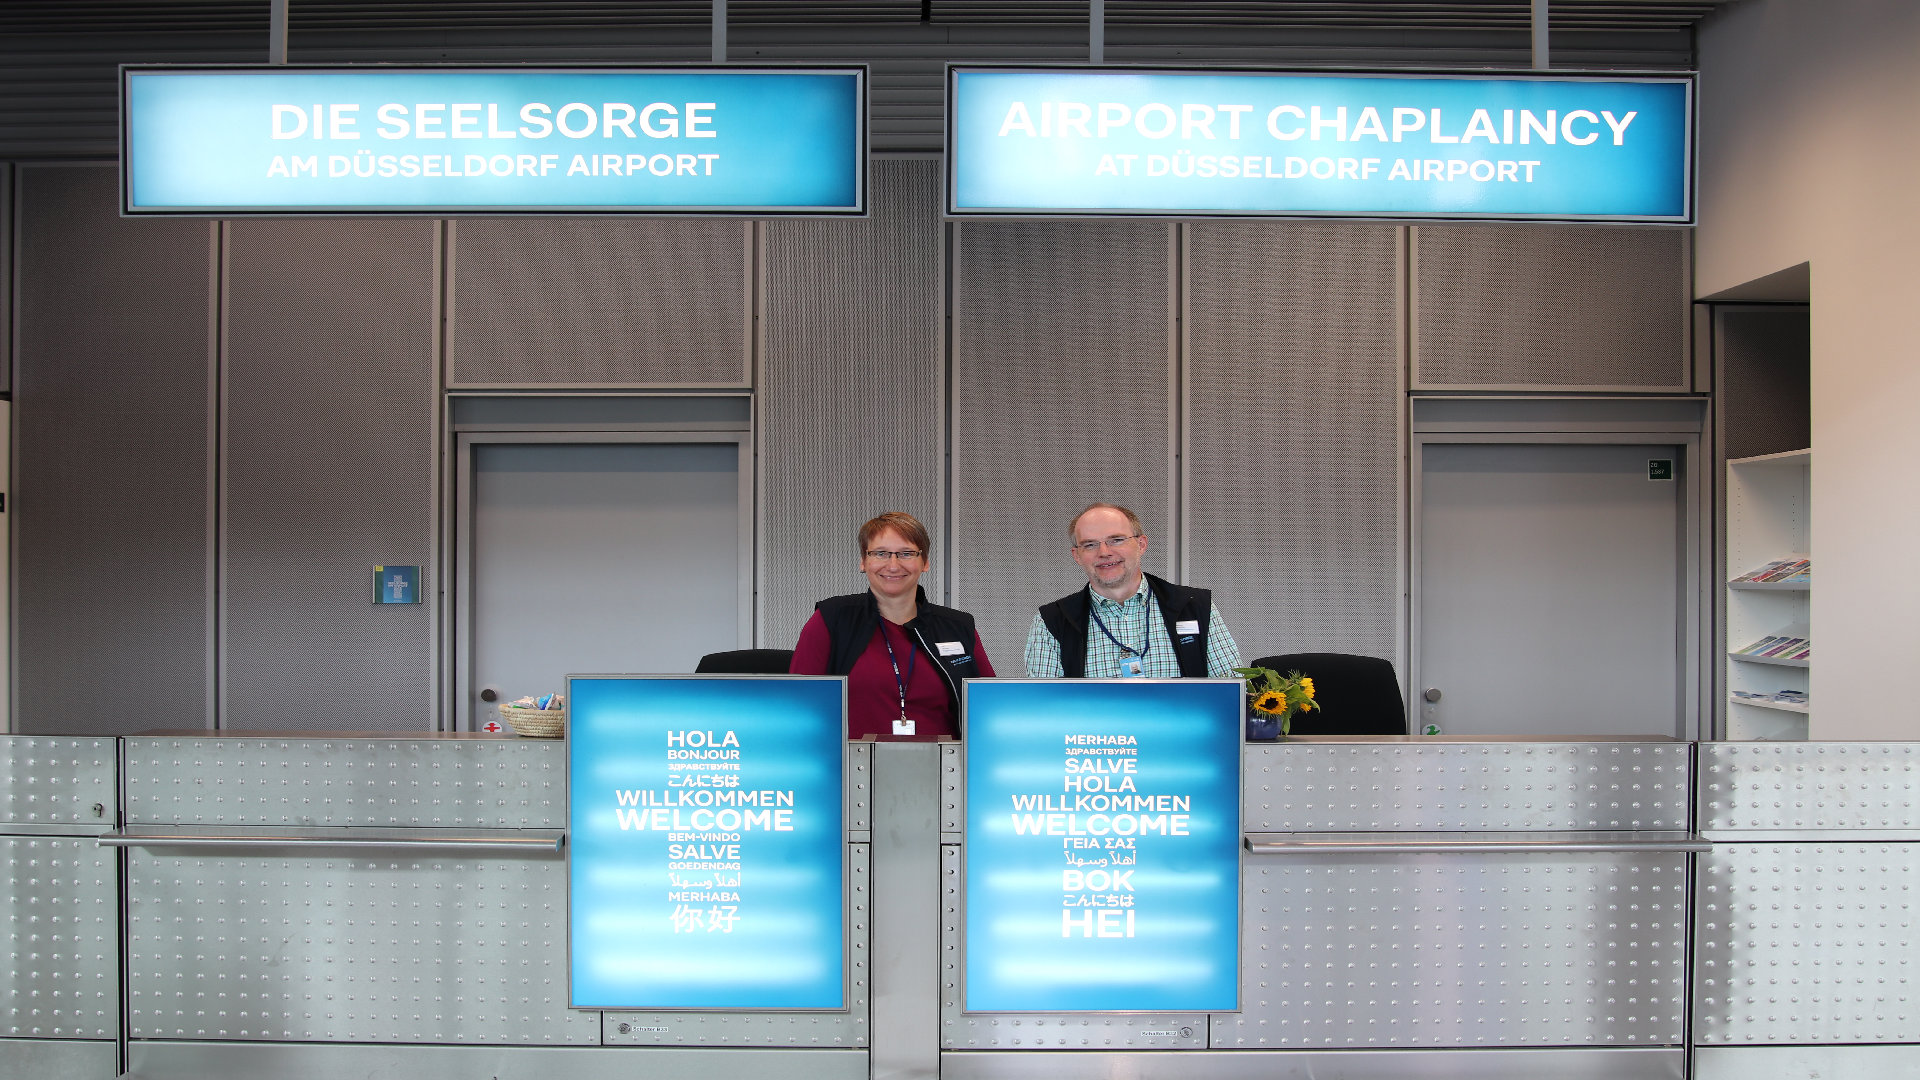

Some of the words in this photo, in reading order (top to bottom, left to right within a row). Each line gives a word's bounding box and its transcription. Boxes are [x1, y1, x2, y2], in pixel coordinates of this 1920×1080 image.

[271, 103, 361, 140] DIE
[376, 102, 717, 140] SEELSORGE
[998, 101, 1254, 140] AIRPORT
[1266, 104, 1638, 146] CHAPLAINCY
[266, 154, 318, 178] AM
[328, 149, 559, 178] DÜSSELDORF
[566, 153, 720, 177] AIRPORT
[1095, 154, 1139, 177] AT
[1147, 150, 1381, 180] DÜSSELDORF
[1387, 158, 1541, 183] AIRPORT
[668, 731, 740, 748] HOLA
[1065, 735, 1137, 745] MERHABA
[668, 750, 740, 760] BONJOUR
[1065, 747, 1137, 755] ЗДРАВСТВУЙТЕ
[668, 762, 740, 771] ЗДРАВСТВУЙТЕ
[1065, 758, 1137, 774] SALVE
[668, 774, 740, 788] こんにちは
[1064, 776, 1136, 792] HOLA
[615, 790, 794, 807] WILLKOMMEN
[1012, 795, 1190, 812] WILLKOMMEN
[615, 809, 794, 831] WELCOME
[1012, 814, 1190, 836] WELCOME
[668, 833, 740, 842] BEM-VINDO
[1063, 838, 1100, 849] ΓΕΙΑ
[1104, 838, 1136, 849] ΣΑΣ
[668, 845, 741, 860] SALVE
[668, 862, 741, 871] GOEDENDAG
[1062, 870, 1135, 892] BOK
[668, 892, 741, 902] MERHABA
[1063, 894, 1135, 907] こんにちは
[669, 904, 741, 934] 你好
[1062, 910, 1135, 938] HEI
